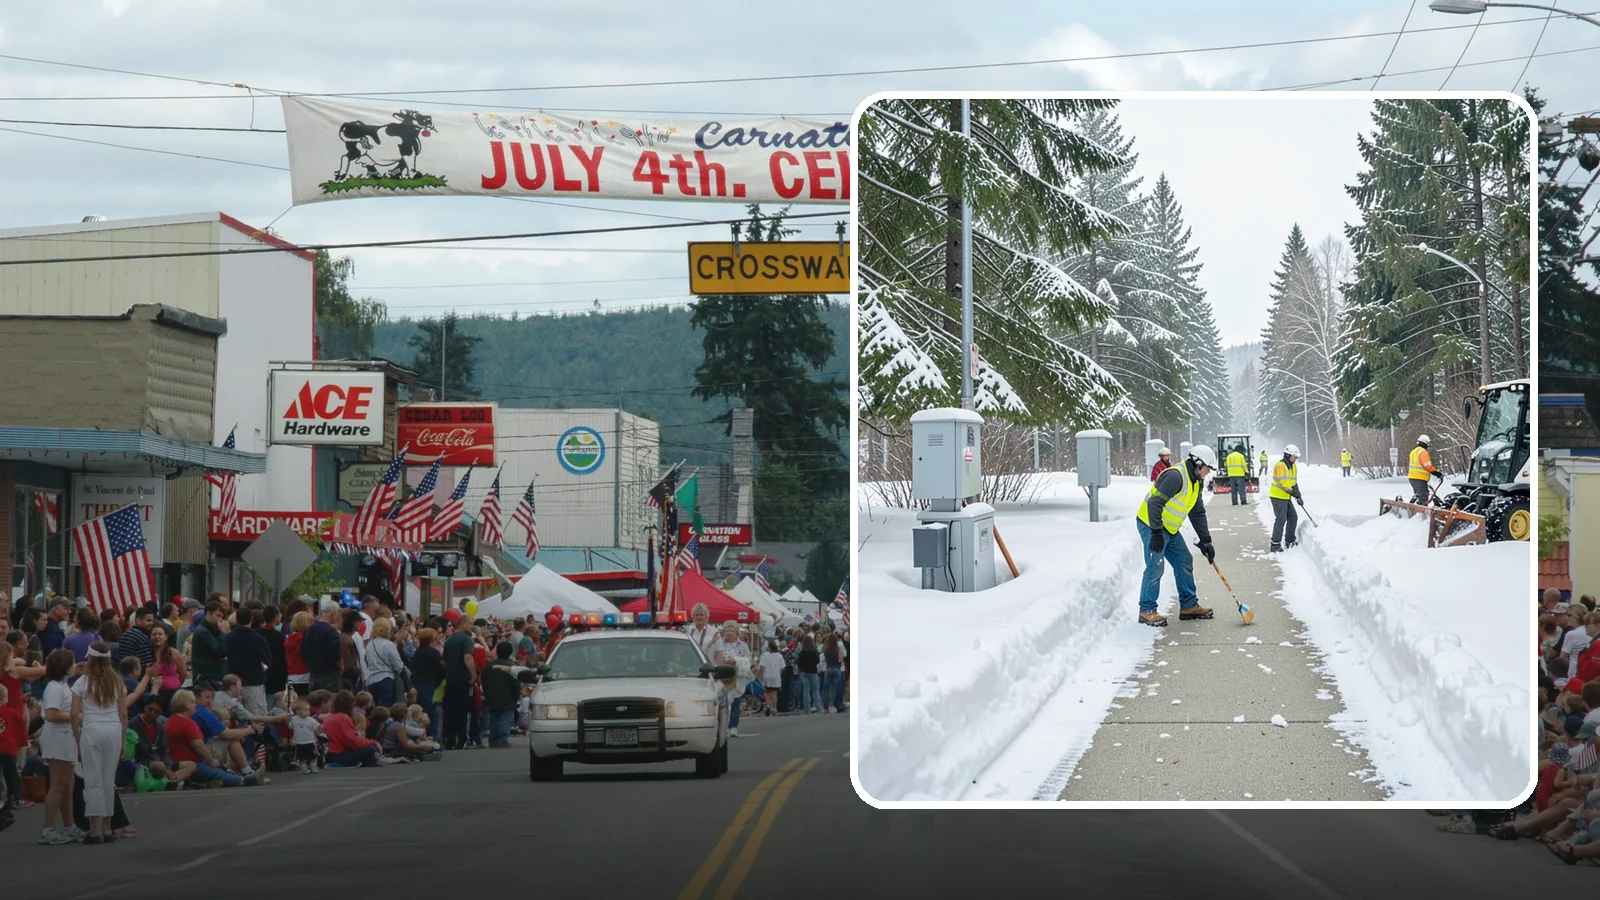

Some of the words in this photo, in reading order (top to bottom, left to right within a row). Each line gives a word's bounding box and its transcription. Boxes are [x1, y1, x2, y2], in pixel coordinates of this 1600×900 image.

[481, 141, 604, 193] JULY
[632, 150, 746, 198] 4th.
[697, 254, 850, 280] CROSSWA
[282, 380, 374, 420] ACE
[405, 409, 453, 422] CEDAR
[283, 421, 371, 437] Hardware
[416, 428, 477, 447] Coca-Cola
[95, 485, 124, 494] Vincent
[126, 486, 136, 494] de
[137, 486, 155, 495] Paul
[688, 526, 741, 535] CRNATION
[699, 535, 730, 543] GLASS
